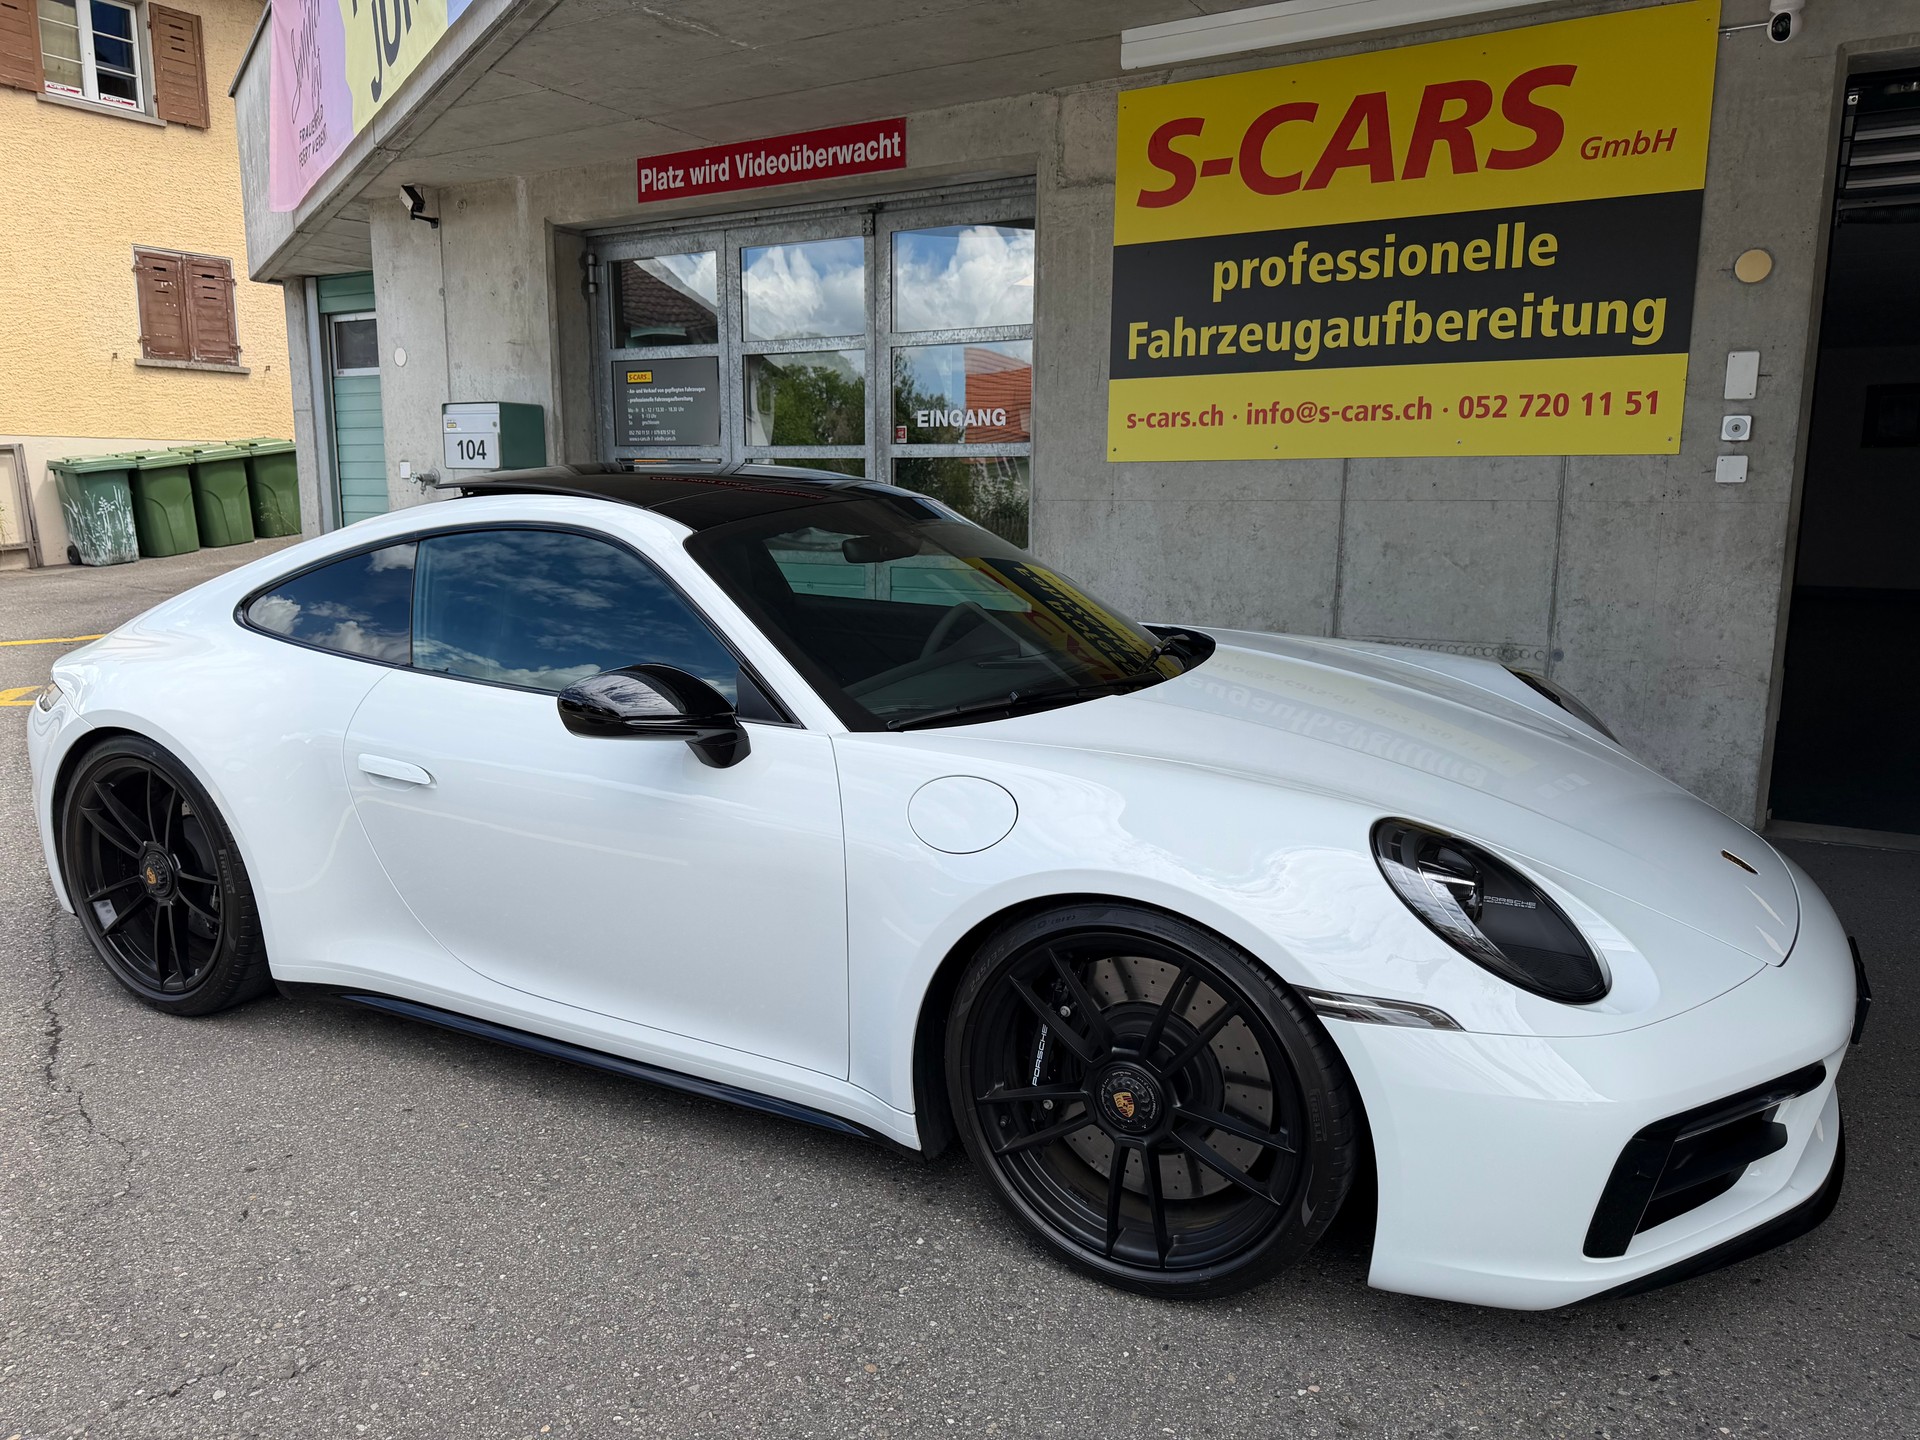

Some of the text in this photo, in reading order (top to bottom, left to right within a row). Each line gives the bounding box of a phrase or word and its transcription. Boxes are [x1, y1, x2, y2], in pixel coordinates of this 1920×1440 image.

[640, 131, 902, 193] Platz wird Videoüberwacht
[1136, 64, 1677, 208] S-CARS GmbH
[1212, 222, 1558, 303] professionelle
[1127, 293, 1667, 361] Fahrzeugaufbereitung
[917, 408, 1006, 427] EINGANG
[1127, 390, 1660, 430] s-cars.ch info@s-cars.ch 052 720 11 51
[457, 440, 487, 460] 104
[1483, 895, 1537, 907] PORSCHE
[1031, 1023, 1049, 1087] PORSCHE
